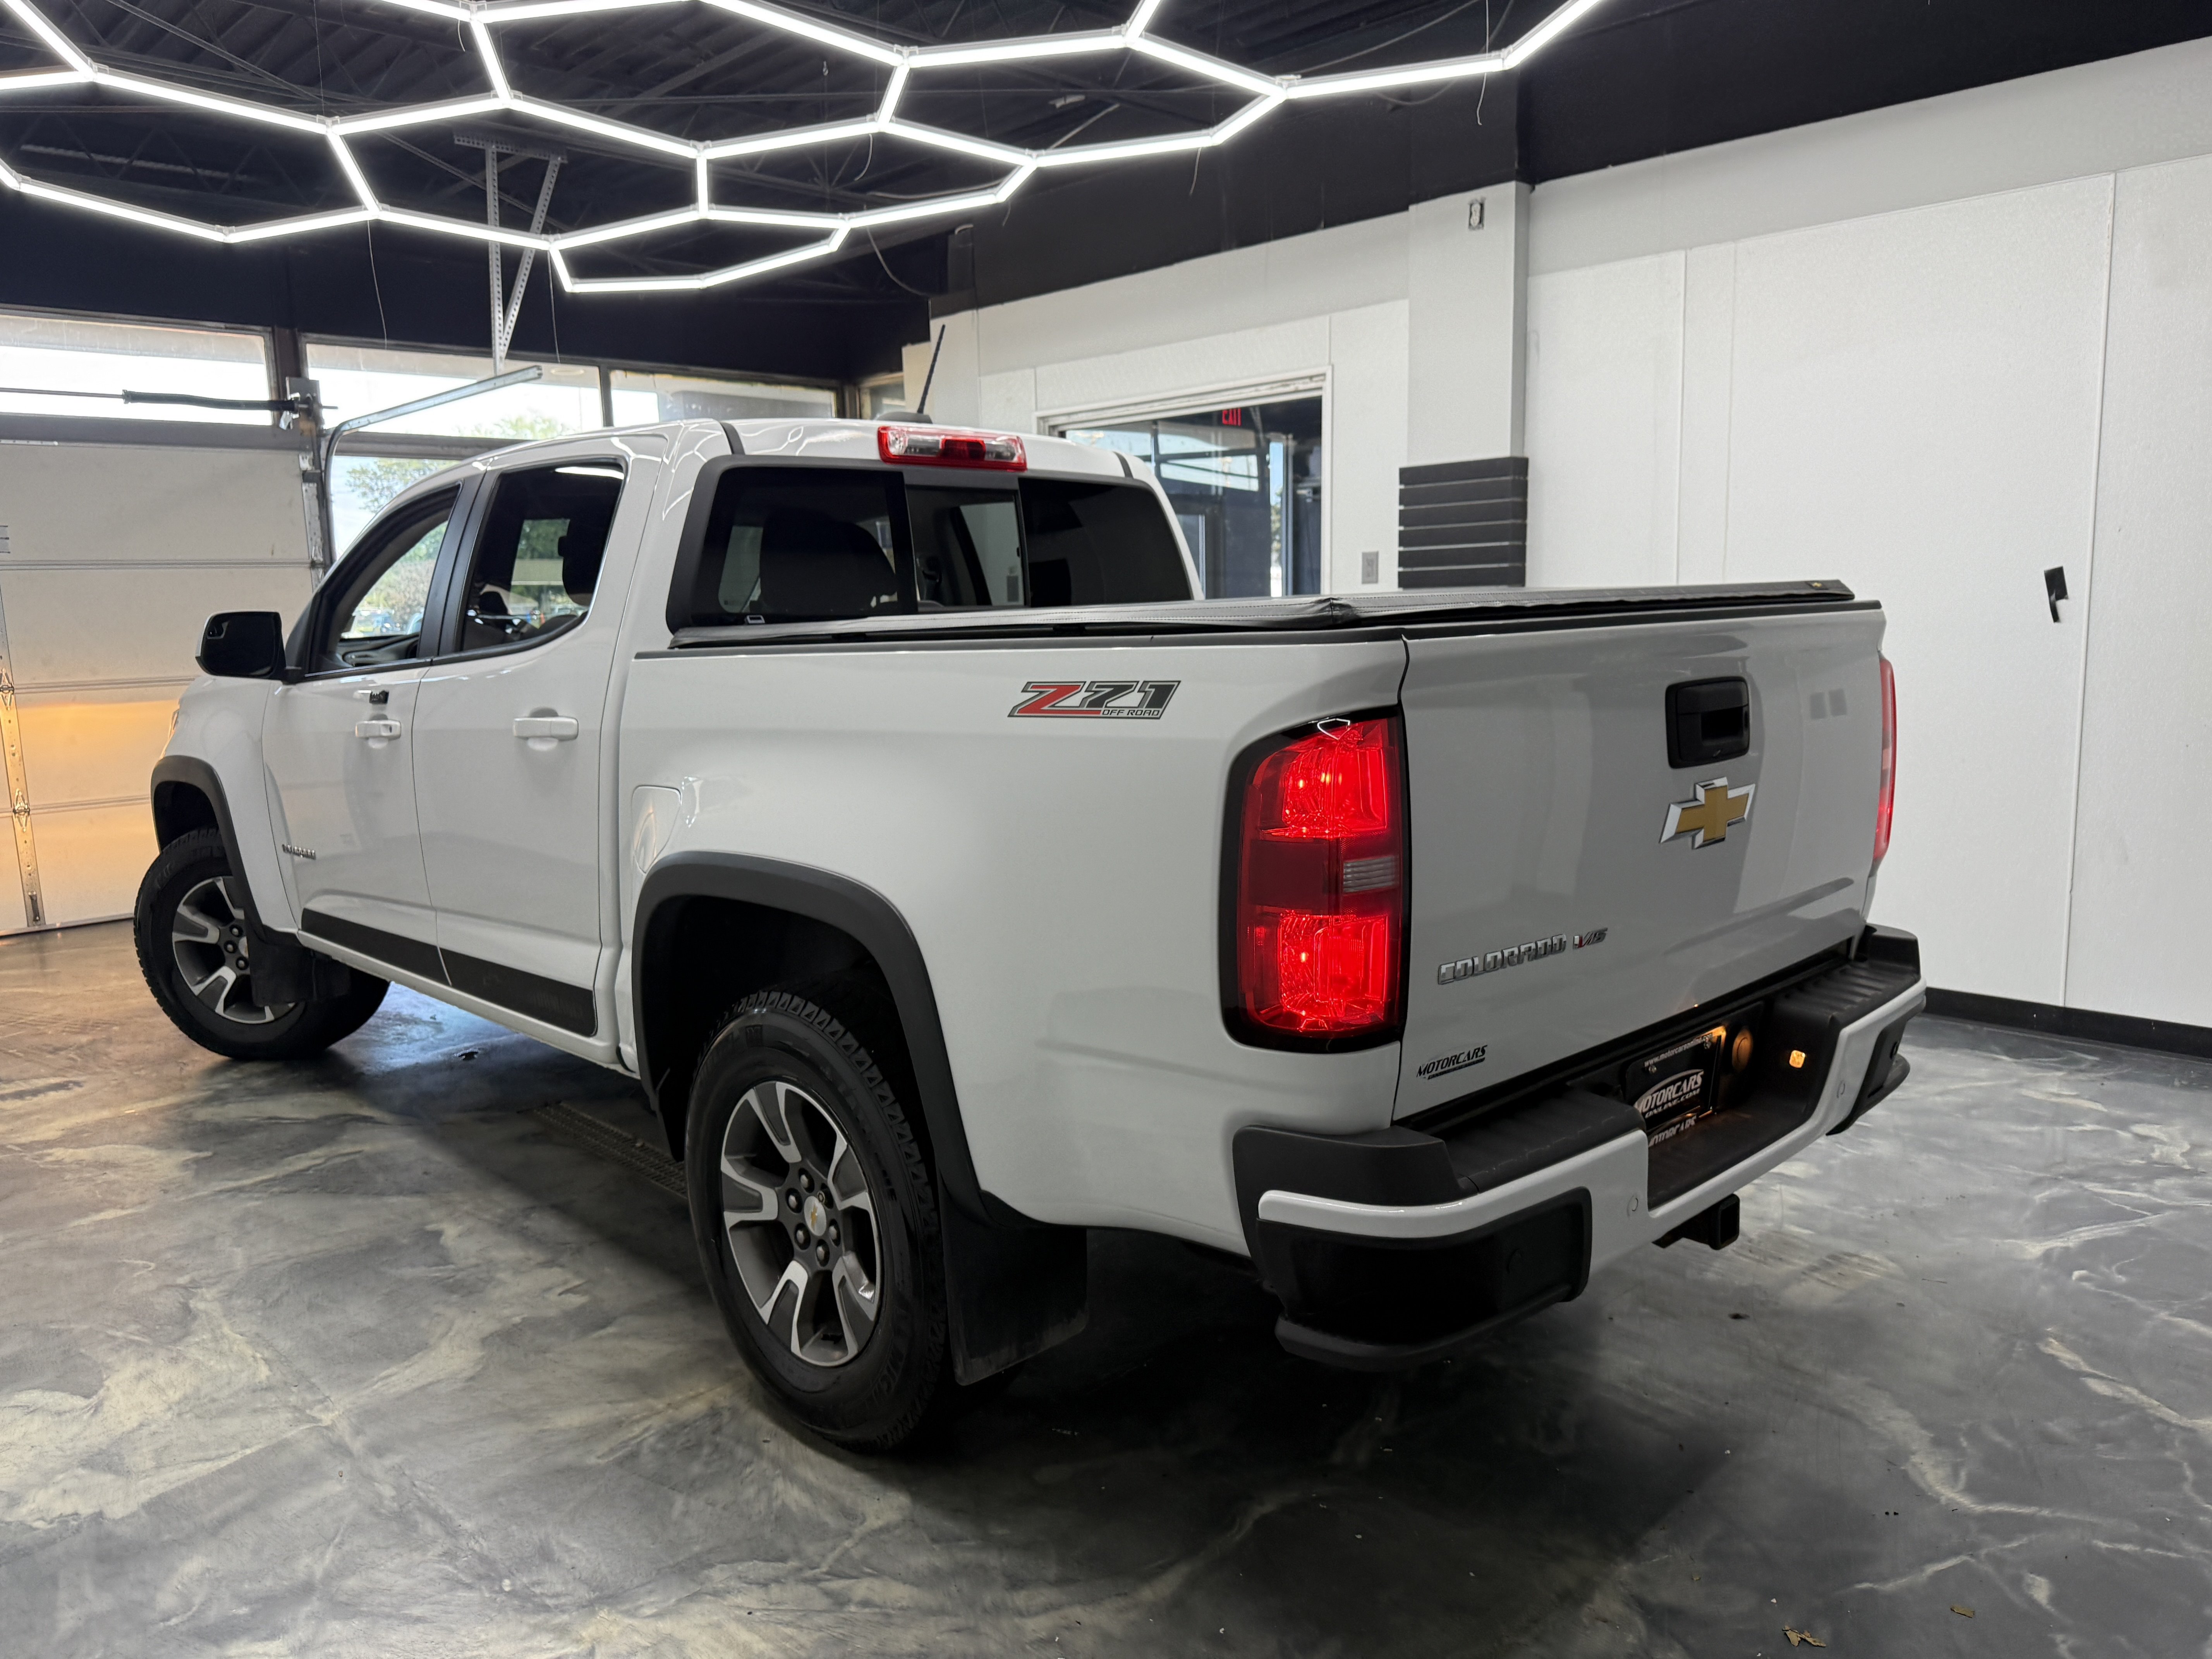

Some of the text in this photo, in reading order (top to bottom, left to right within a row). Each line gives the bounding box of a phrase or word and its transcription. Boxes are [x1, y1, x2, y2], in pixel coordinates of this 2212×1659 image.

[1007, 680, 1182, 720] Z71
[1437, 927, 1608, 985] COLORADO V6
[1416, 1044, 1488, 1078] MOTORCARS
